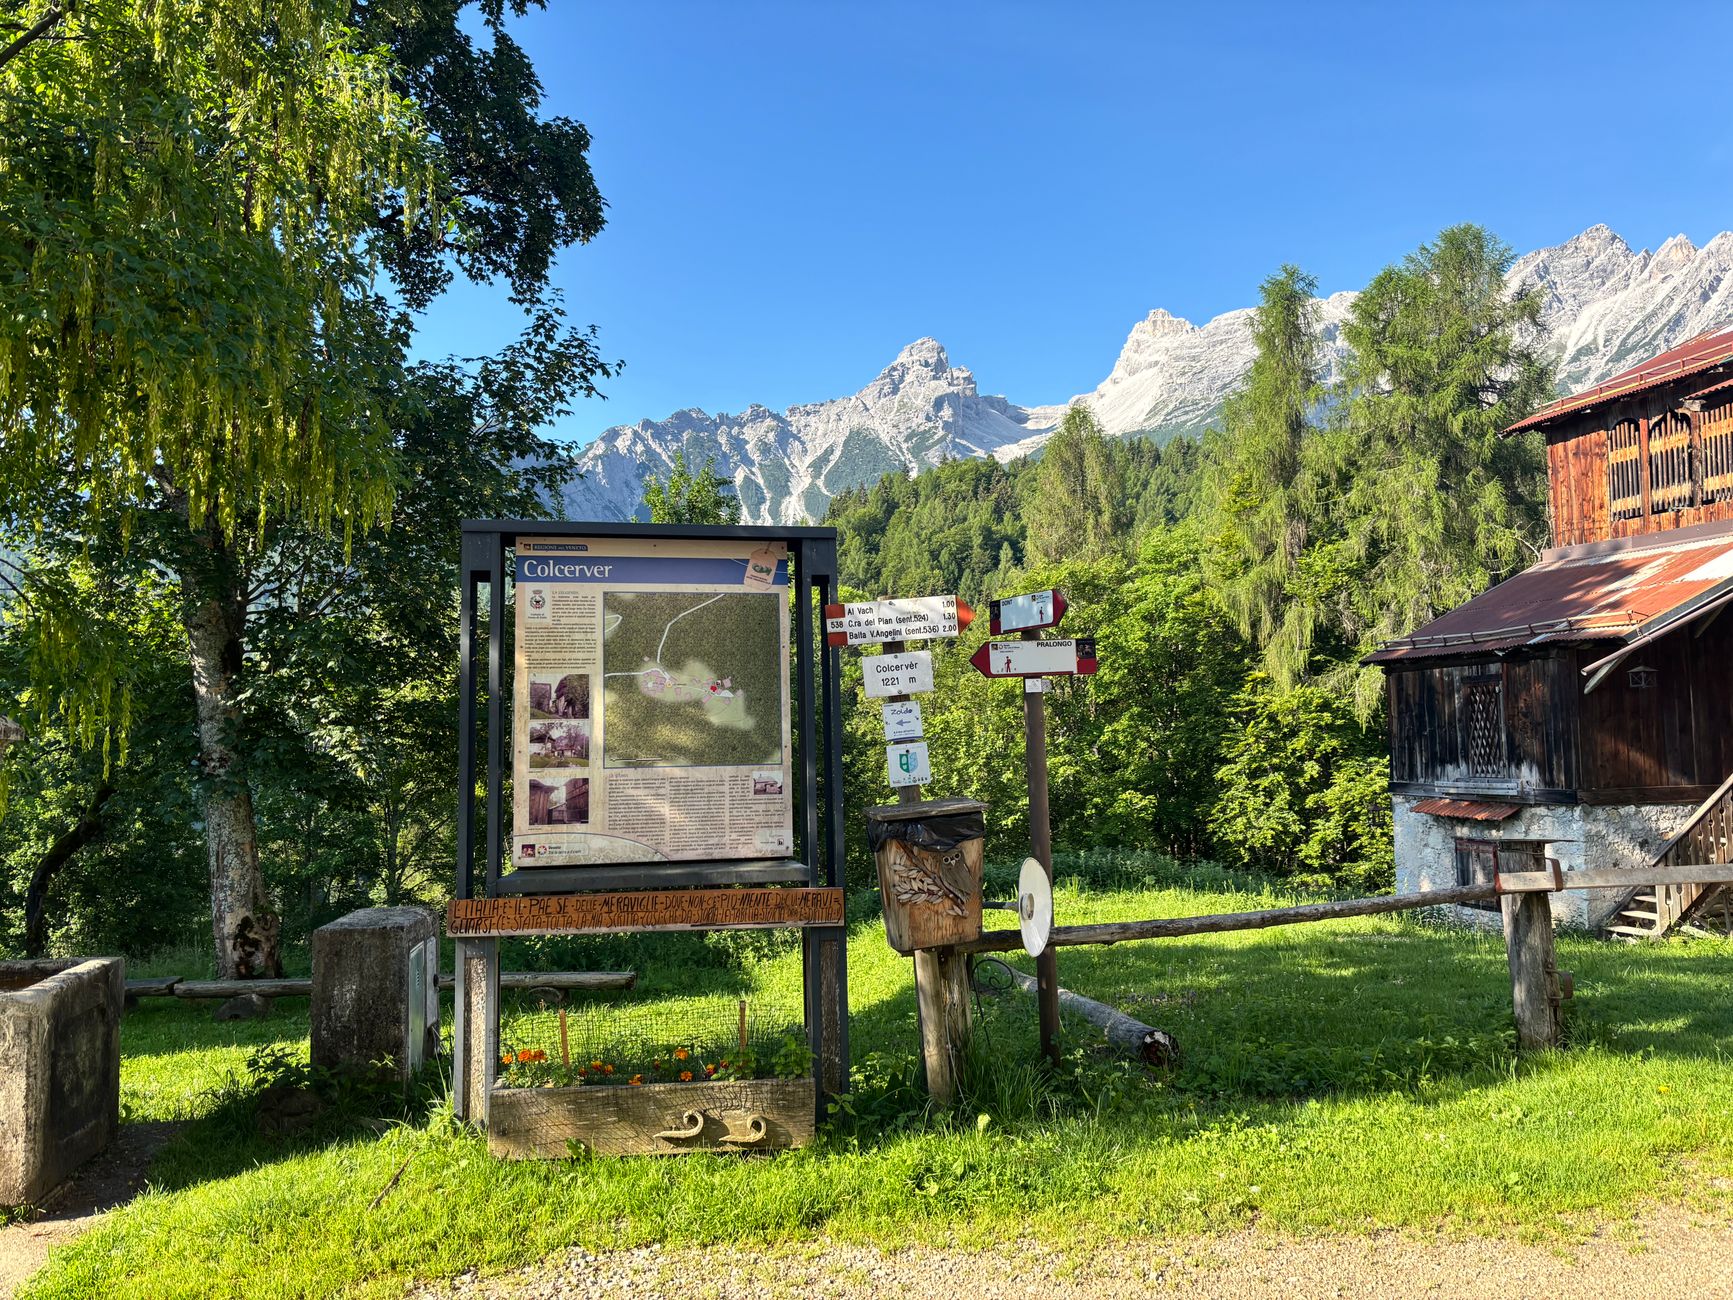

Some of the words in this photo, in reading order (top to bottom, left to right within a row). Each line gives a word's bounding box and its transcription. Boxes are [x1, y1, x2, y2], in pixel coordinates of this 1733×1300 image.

[524, 559, 613, 578] Colcerver
[847, 608, 855, 616] Al
[858, 606, 874, 615] Vach
[942, 600, 955, 608] 1.00
[848, 619, 862, 628] C.ra
[865, 619, 876, 627] del
[878, 617, 893, 625] Plan
[896, 614, 929, 624] (sent.524)
[943, 612, 956, 620] 1.30
[849, 631, 867, 640] Baita
[870, 628, 903, 639] V.Angelini
[905, 625, 940, 635] (sent.536)
[943, 624, 957, 633] 2.00
[881, 677, 900, 687] 1221
[908, 676, 917, 684] m
